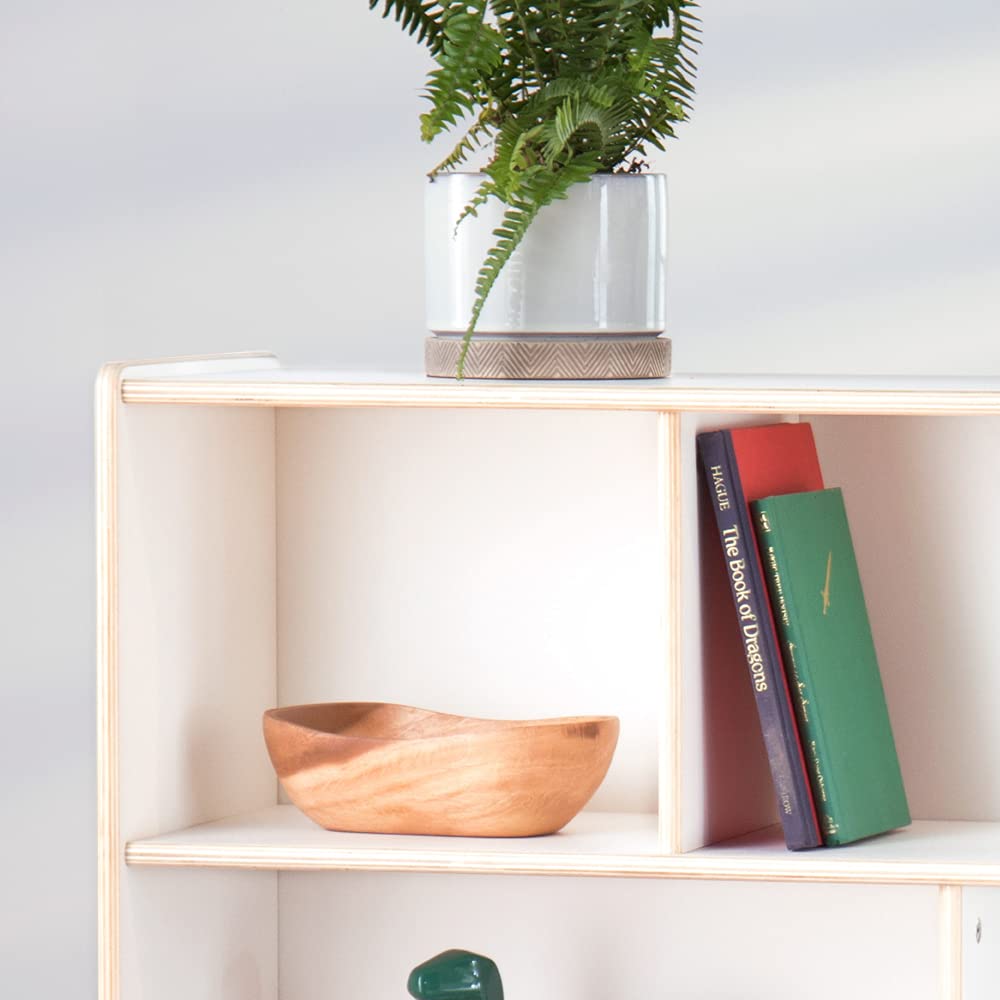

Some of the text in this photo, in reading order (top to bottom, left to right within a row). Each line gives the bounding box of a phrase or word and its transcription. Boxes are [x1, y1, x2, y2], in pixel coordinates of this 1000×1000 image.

[710, 465, 731, 511] HAGUE
[722, 524, 768, 692] The Book of Dragons
